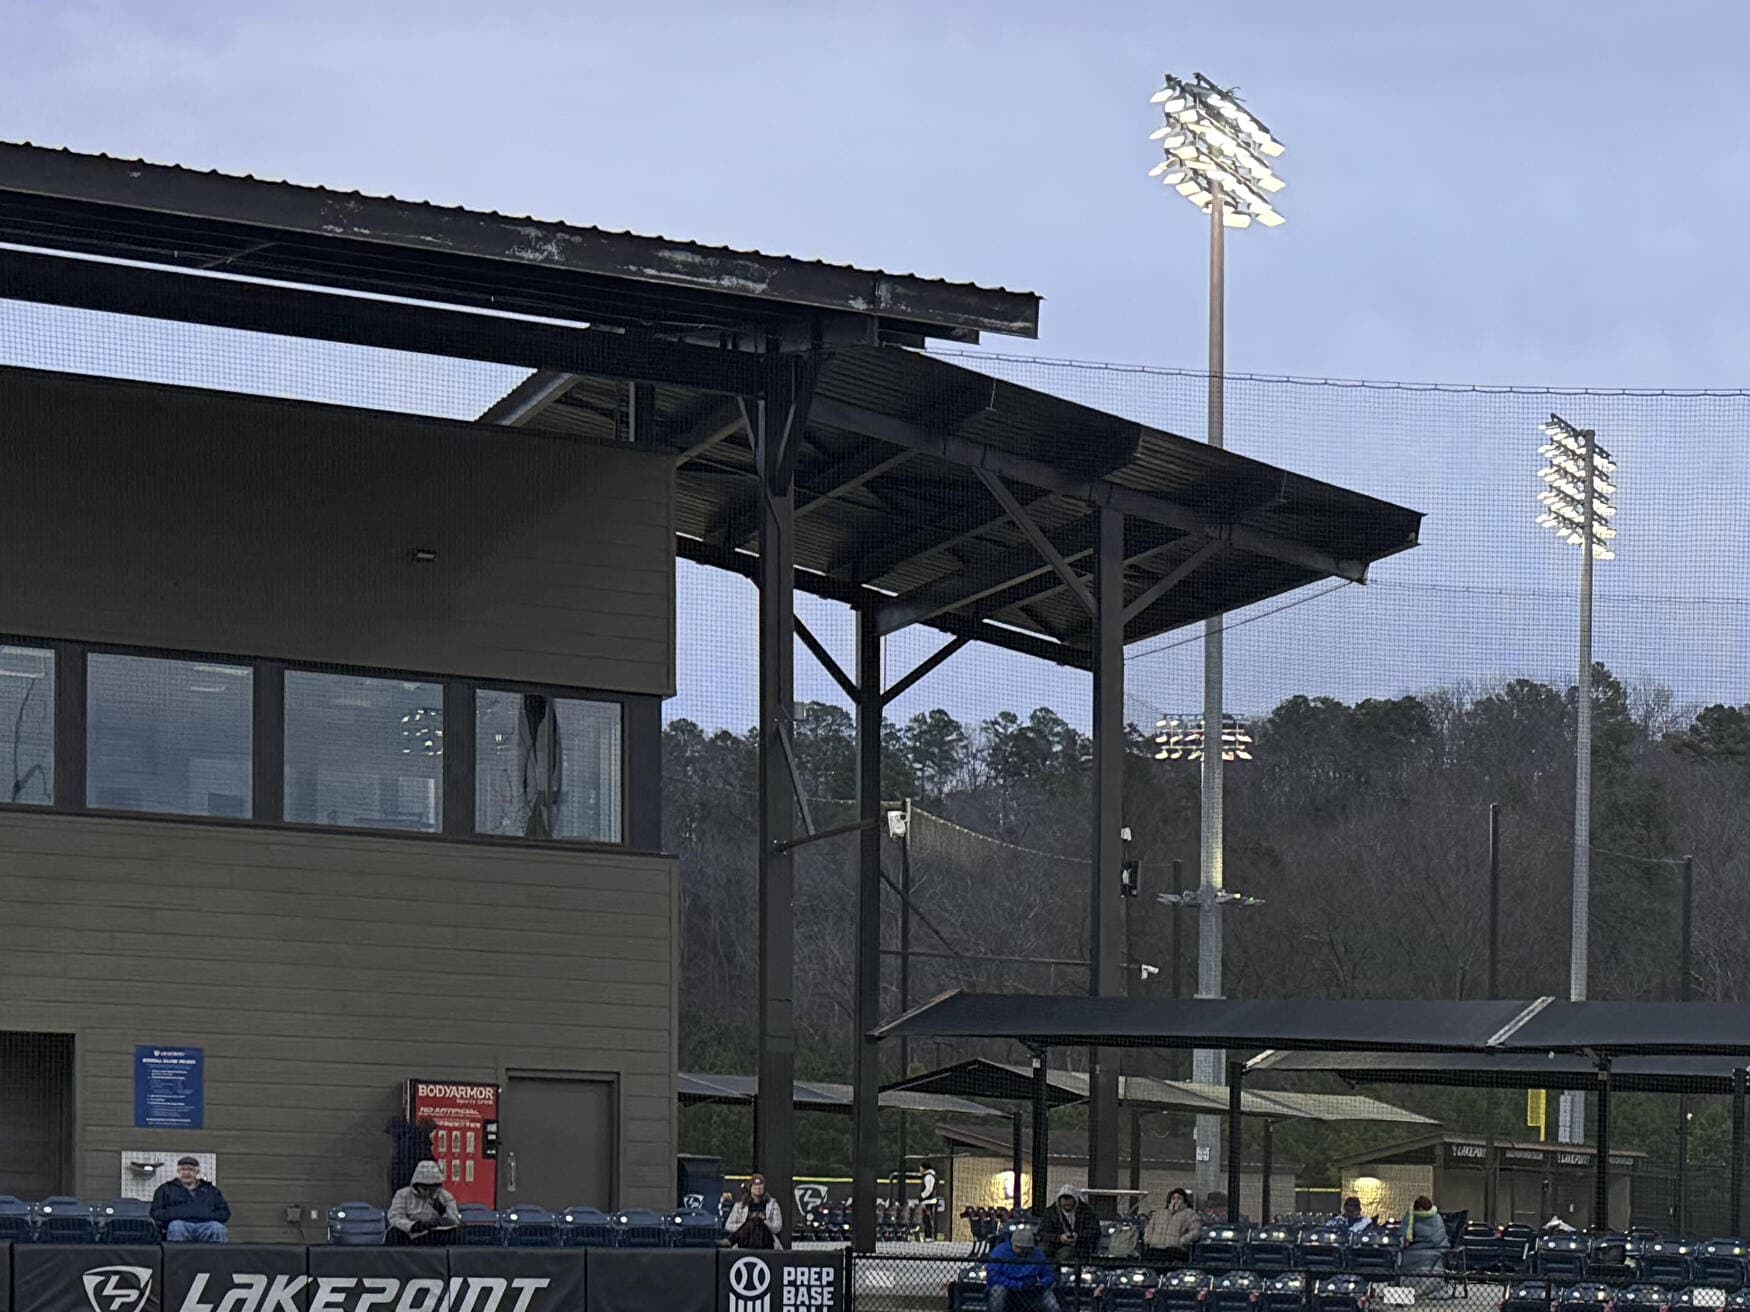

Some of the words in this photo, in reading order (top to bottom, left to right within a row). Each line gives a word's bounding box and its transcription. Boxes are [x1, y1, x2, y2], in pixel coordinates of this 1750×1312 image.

[418, 1084, 494, 1099] BODYARMOR
[783, 1266, 835, 1286] PREP
[783, 1286, 835, 1305] BASE
